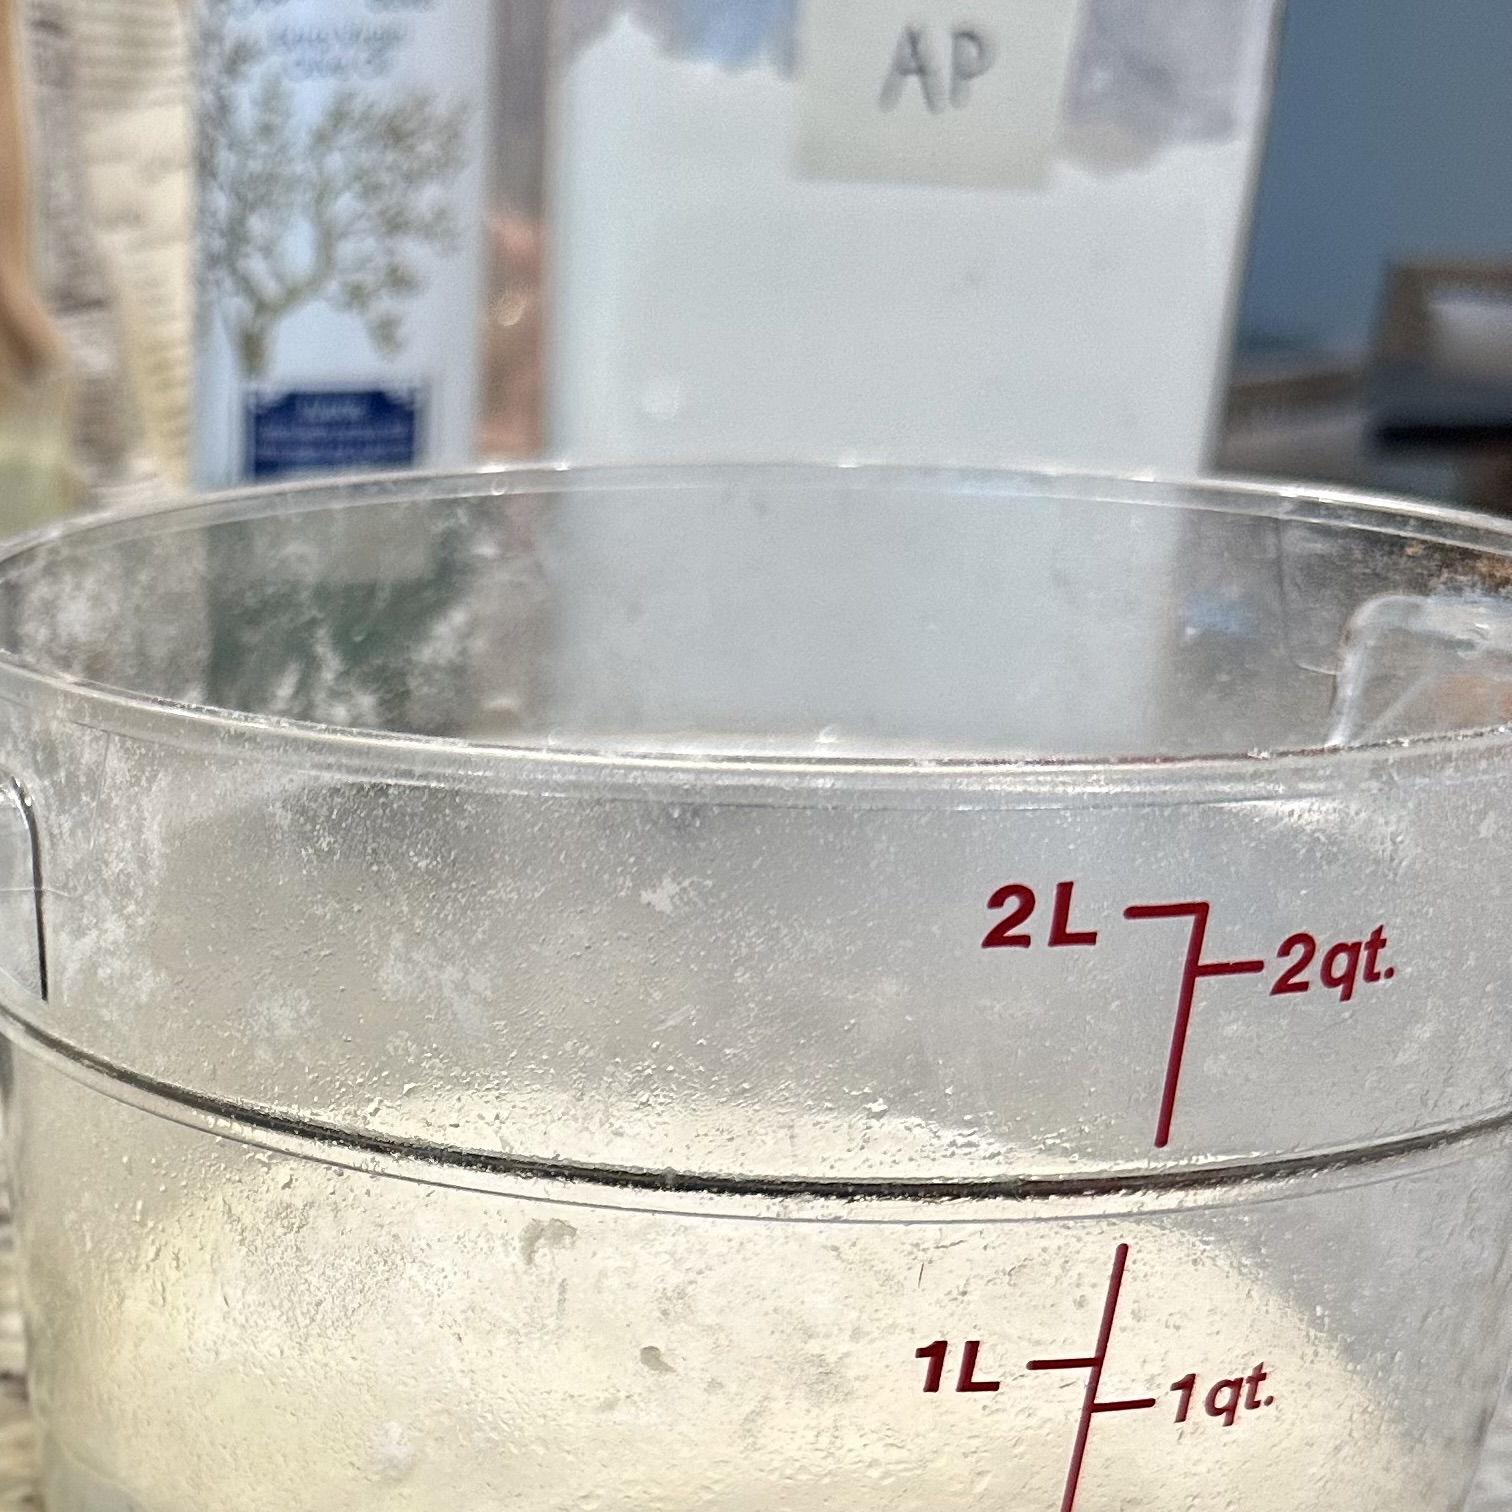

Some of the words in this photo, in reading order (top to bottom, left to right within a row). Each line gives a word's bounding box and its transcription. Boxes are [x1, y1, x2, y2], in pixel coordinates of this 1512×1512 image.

[878, 22, 998, 113] AP
[981, 881, 1098, 949] 2L
[1269, 923, 1396, 1002] 2qt.
[914, 1340, 1001, 1393] 1L
[1169, 1361, 1274, 1427] 1qt.
